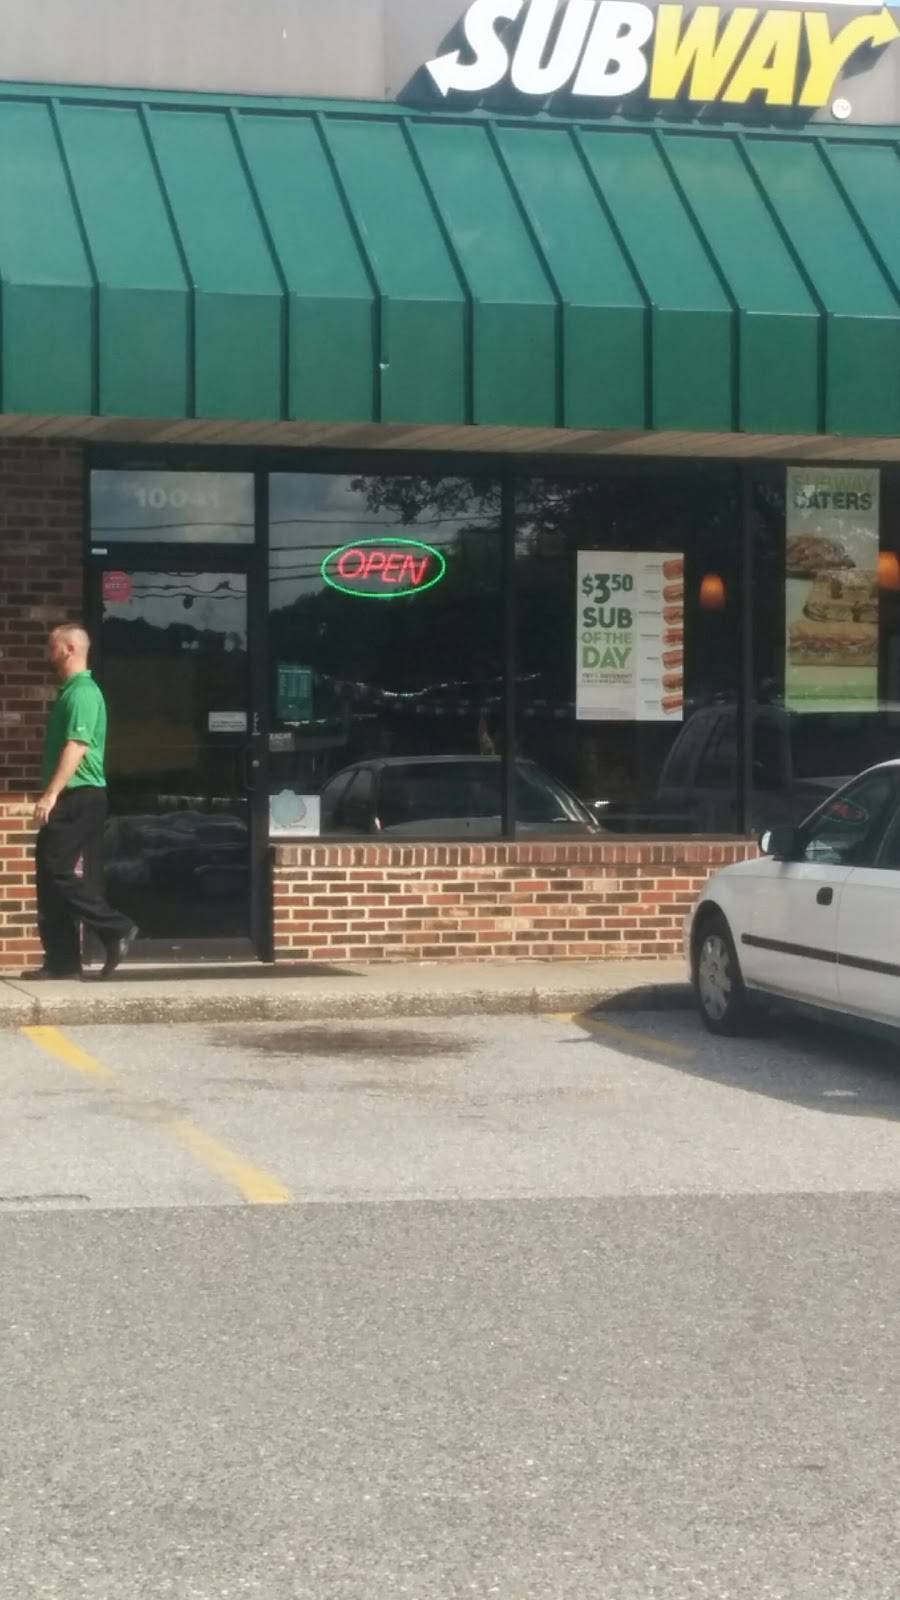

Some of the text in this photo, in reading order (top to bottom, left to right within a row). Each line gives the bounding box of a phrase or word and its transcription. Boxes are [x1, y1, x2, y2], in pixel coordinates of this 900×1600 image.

[425, 0, 899, 106] SUBWAY
[793, 491, 872, 511] CATERS
[337, 548, 430, 586] OPEN
[582, 606, 633, 629] SUB
[581, 631, 633, 645] OF THE
[582, 646, 633, 669] DAY
